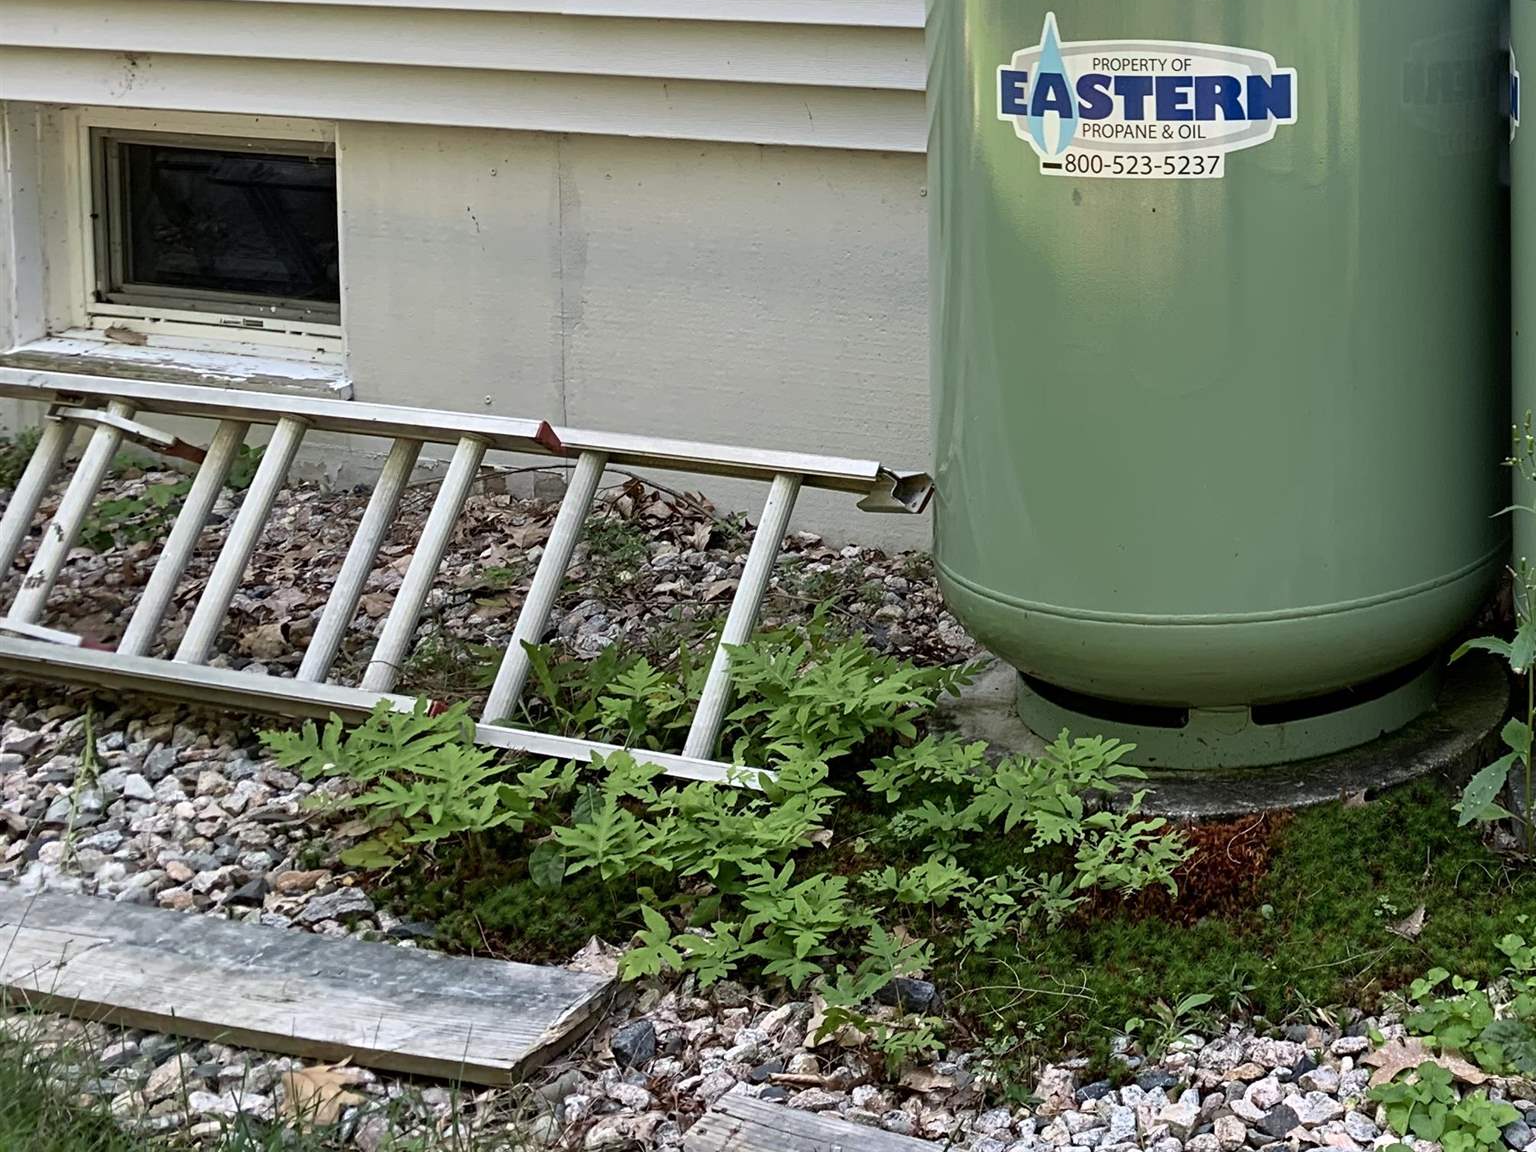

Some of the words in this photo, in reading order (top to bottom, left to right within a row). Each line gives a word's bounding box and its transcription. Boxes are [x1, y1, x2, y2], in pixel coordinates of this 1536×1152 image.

[1092, 57, 1168, 71] PROPERTY
[1171, 58, 1192, 72] OF
[1000, 69, 1291, 121] EASTERN
[1082, 123, 1157, 139] PROPANE
[1161, 124, 1174, 139] &
[1178, 124, 1206, 139] OIL
